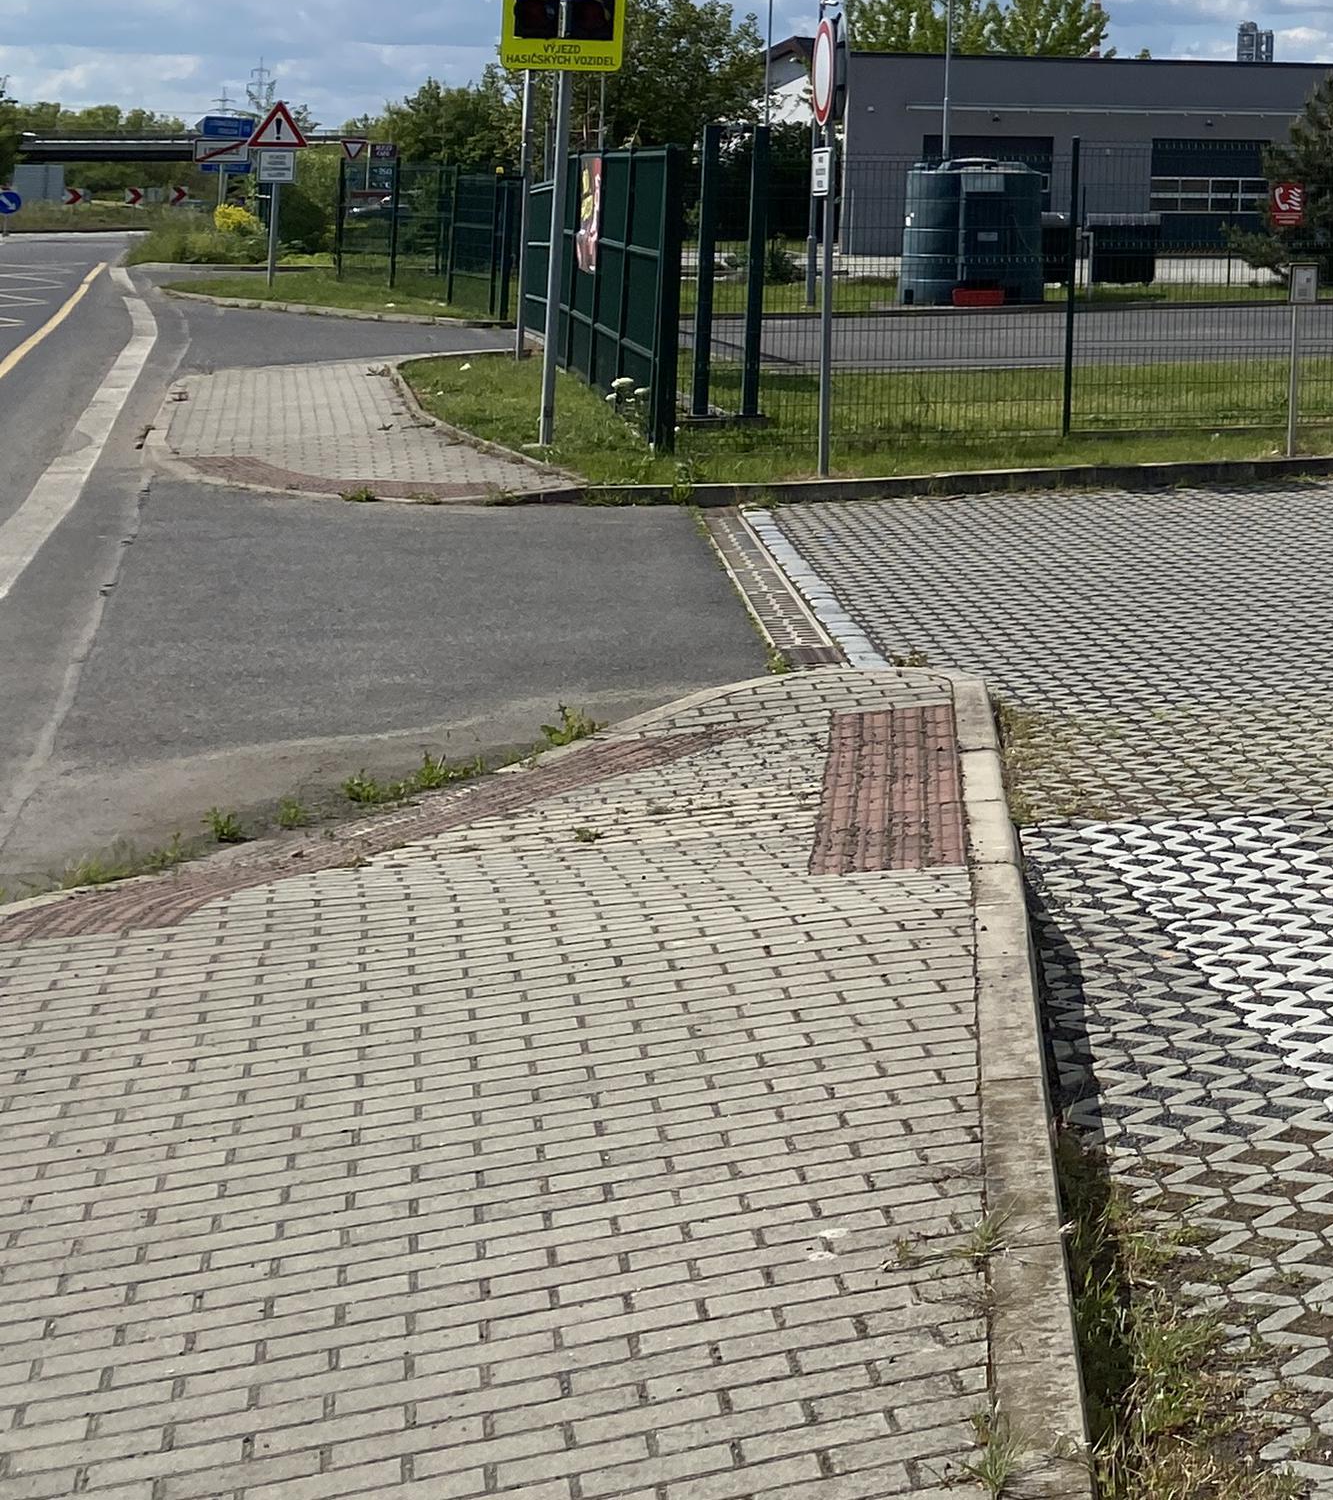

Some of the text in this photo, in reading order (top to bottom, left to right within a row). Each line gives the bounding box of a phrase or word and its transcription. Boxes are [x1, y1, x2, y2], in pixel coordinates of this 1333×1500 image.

[543, 41, 581, 55] VÝJEZD
[506, 52, 616, 67] HASIČSKÝCH VOZIDEL
